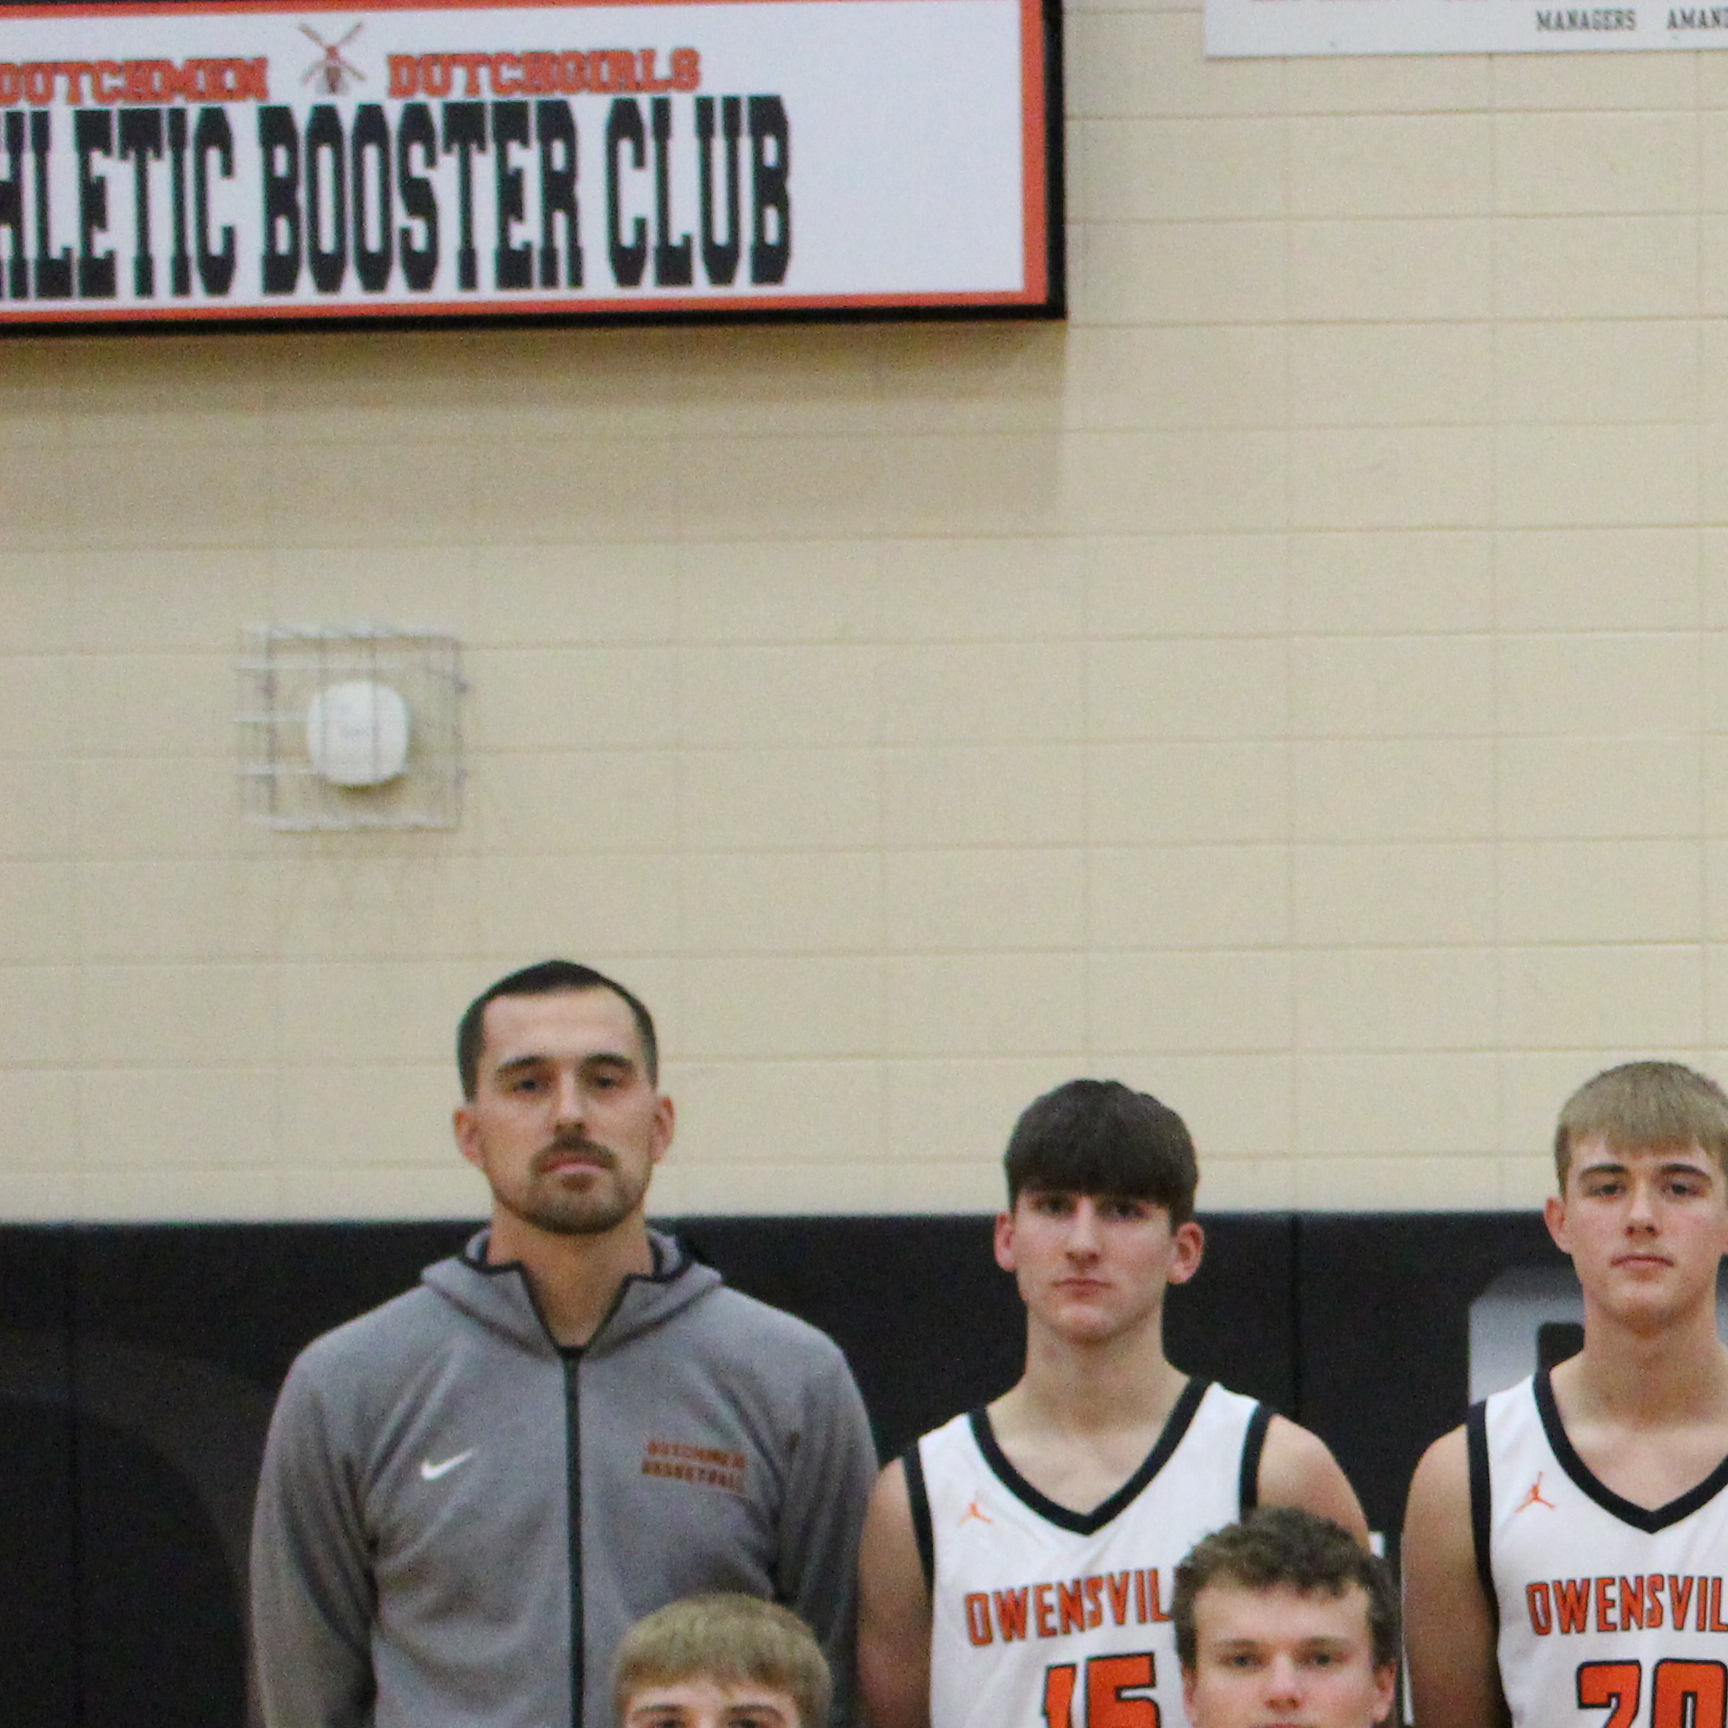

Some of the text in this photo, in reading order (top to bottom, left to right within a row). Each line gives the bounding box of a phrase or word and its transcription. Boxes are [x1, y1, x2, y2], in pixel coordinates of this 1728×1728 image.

[1536, 8, 1636, 31] MANAGERS
[258, 99, 584, 296] BOOSTER
[606, 94, 791, 289] CLUB
[964, 1568, 1171, 1647] OWENSVIL
